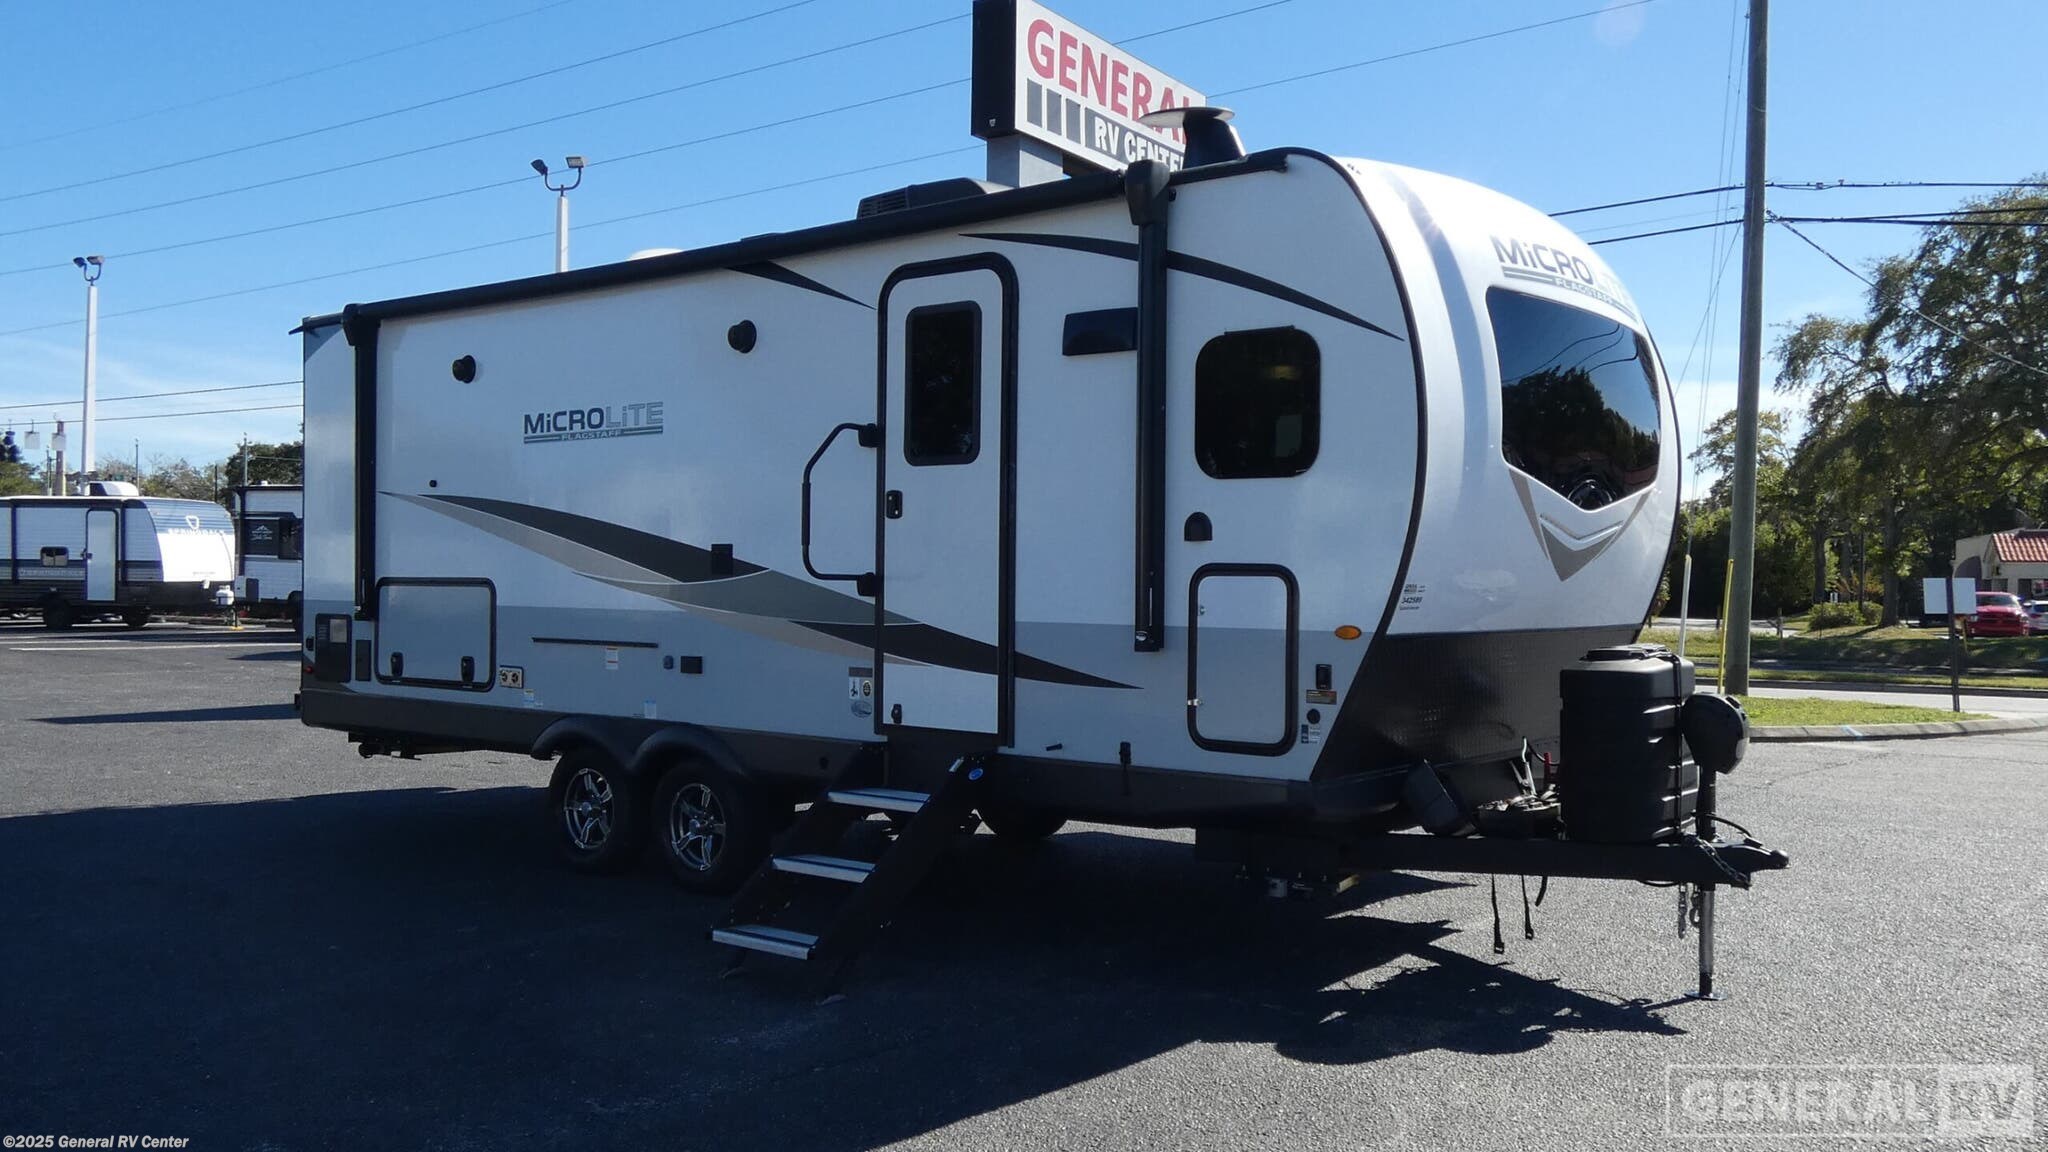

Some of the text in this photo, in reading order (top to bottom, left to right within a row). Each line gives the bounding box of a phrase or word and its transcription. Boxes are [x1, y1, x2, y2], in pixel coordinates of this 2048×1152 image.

[1094, 116, 1184, 173] RV CENTE
[561, 429, 623, 441] FLAGSTAFF
